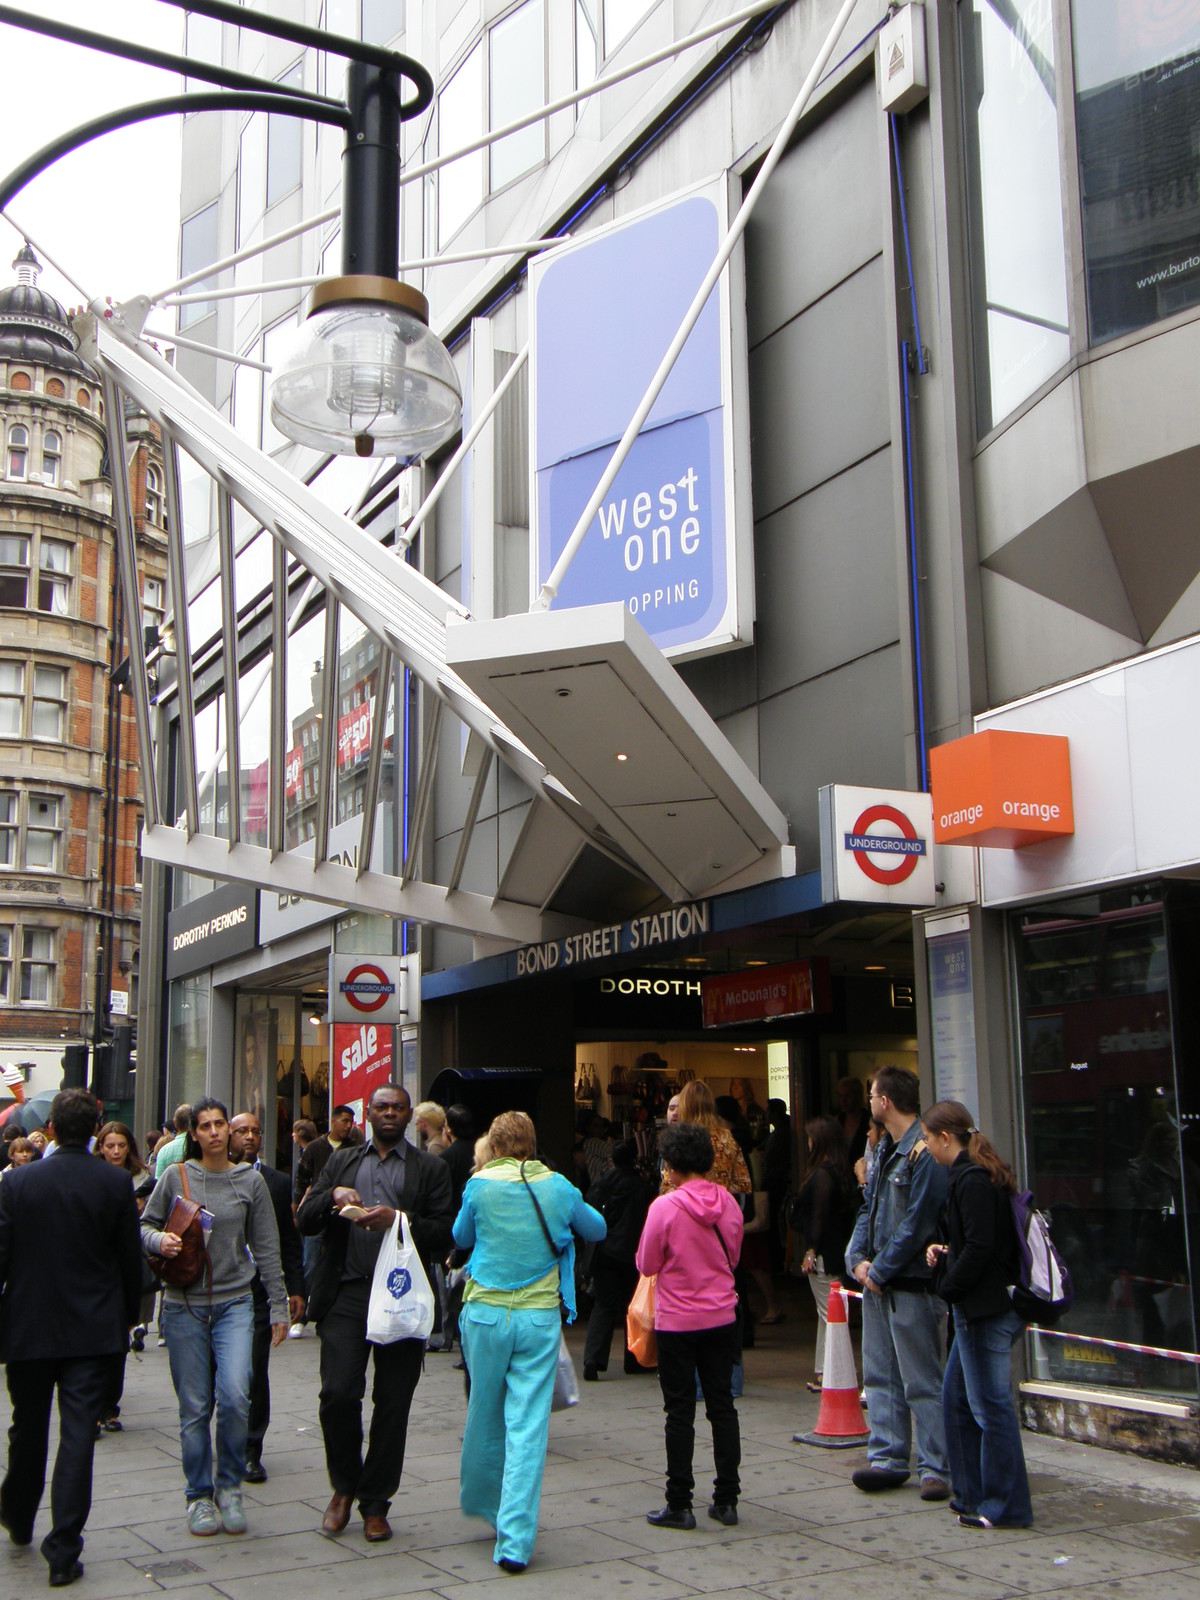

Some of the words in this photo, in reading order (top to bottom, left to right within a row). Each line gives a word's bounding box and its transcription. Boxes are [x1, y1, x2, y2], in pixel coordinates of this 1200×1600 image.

[598, 467, 699, 540] west
[624, 516, 700, 571] one
[940, 804, 983, 828] orange
[1002, 801, 1060, 821] orange
[849, 838, 922, 851] UNDERGROUND
[173, 921, 209, 951] DOROTHY
[210, 905, 247, 935] PERKINS
[517, 941, 561, 975] BOND
[564, 925, 622, 965] STREET
[630, 902, 709, 949] STATION
[944, 951, 965, 963] west
[950, 960, 966, 974] one
[342, 984, 393, 992] UNDERGROUND
[725, 983, 787, 1007] McDonald's
[341, 1024, 378, 1079] sale
[1070, 1061, 1088, 1071] August
